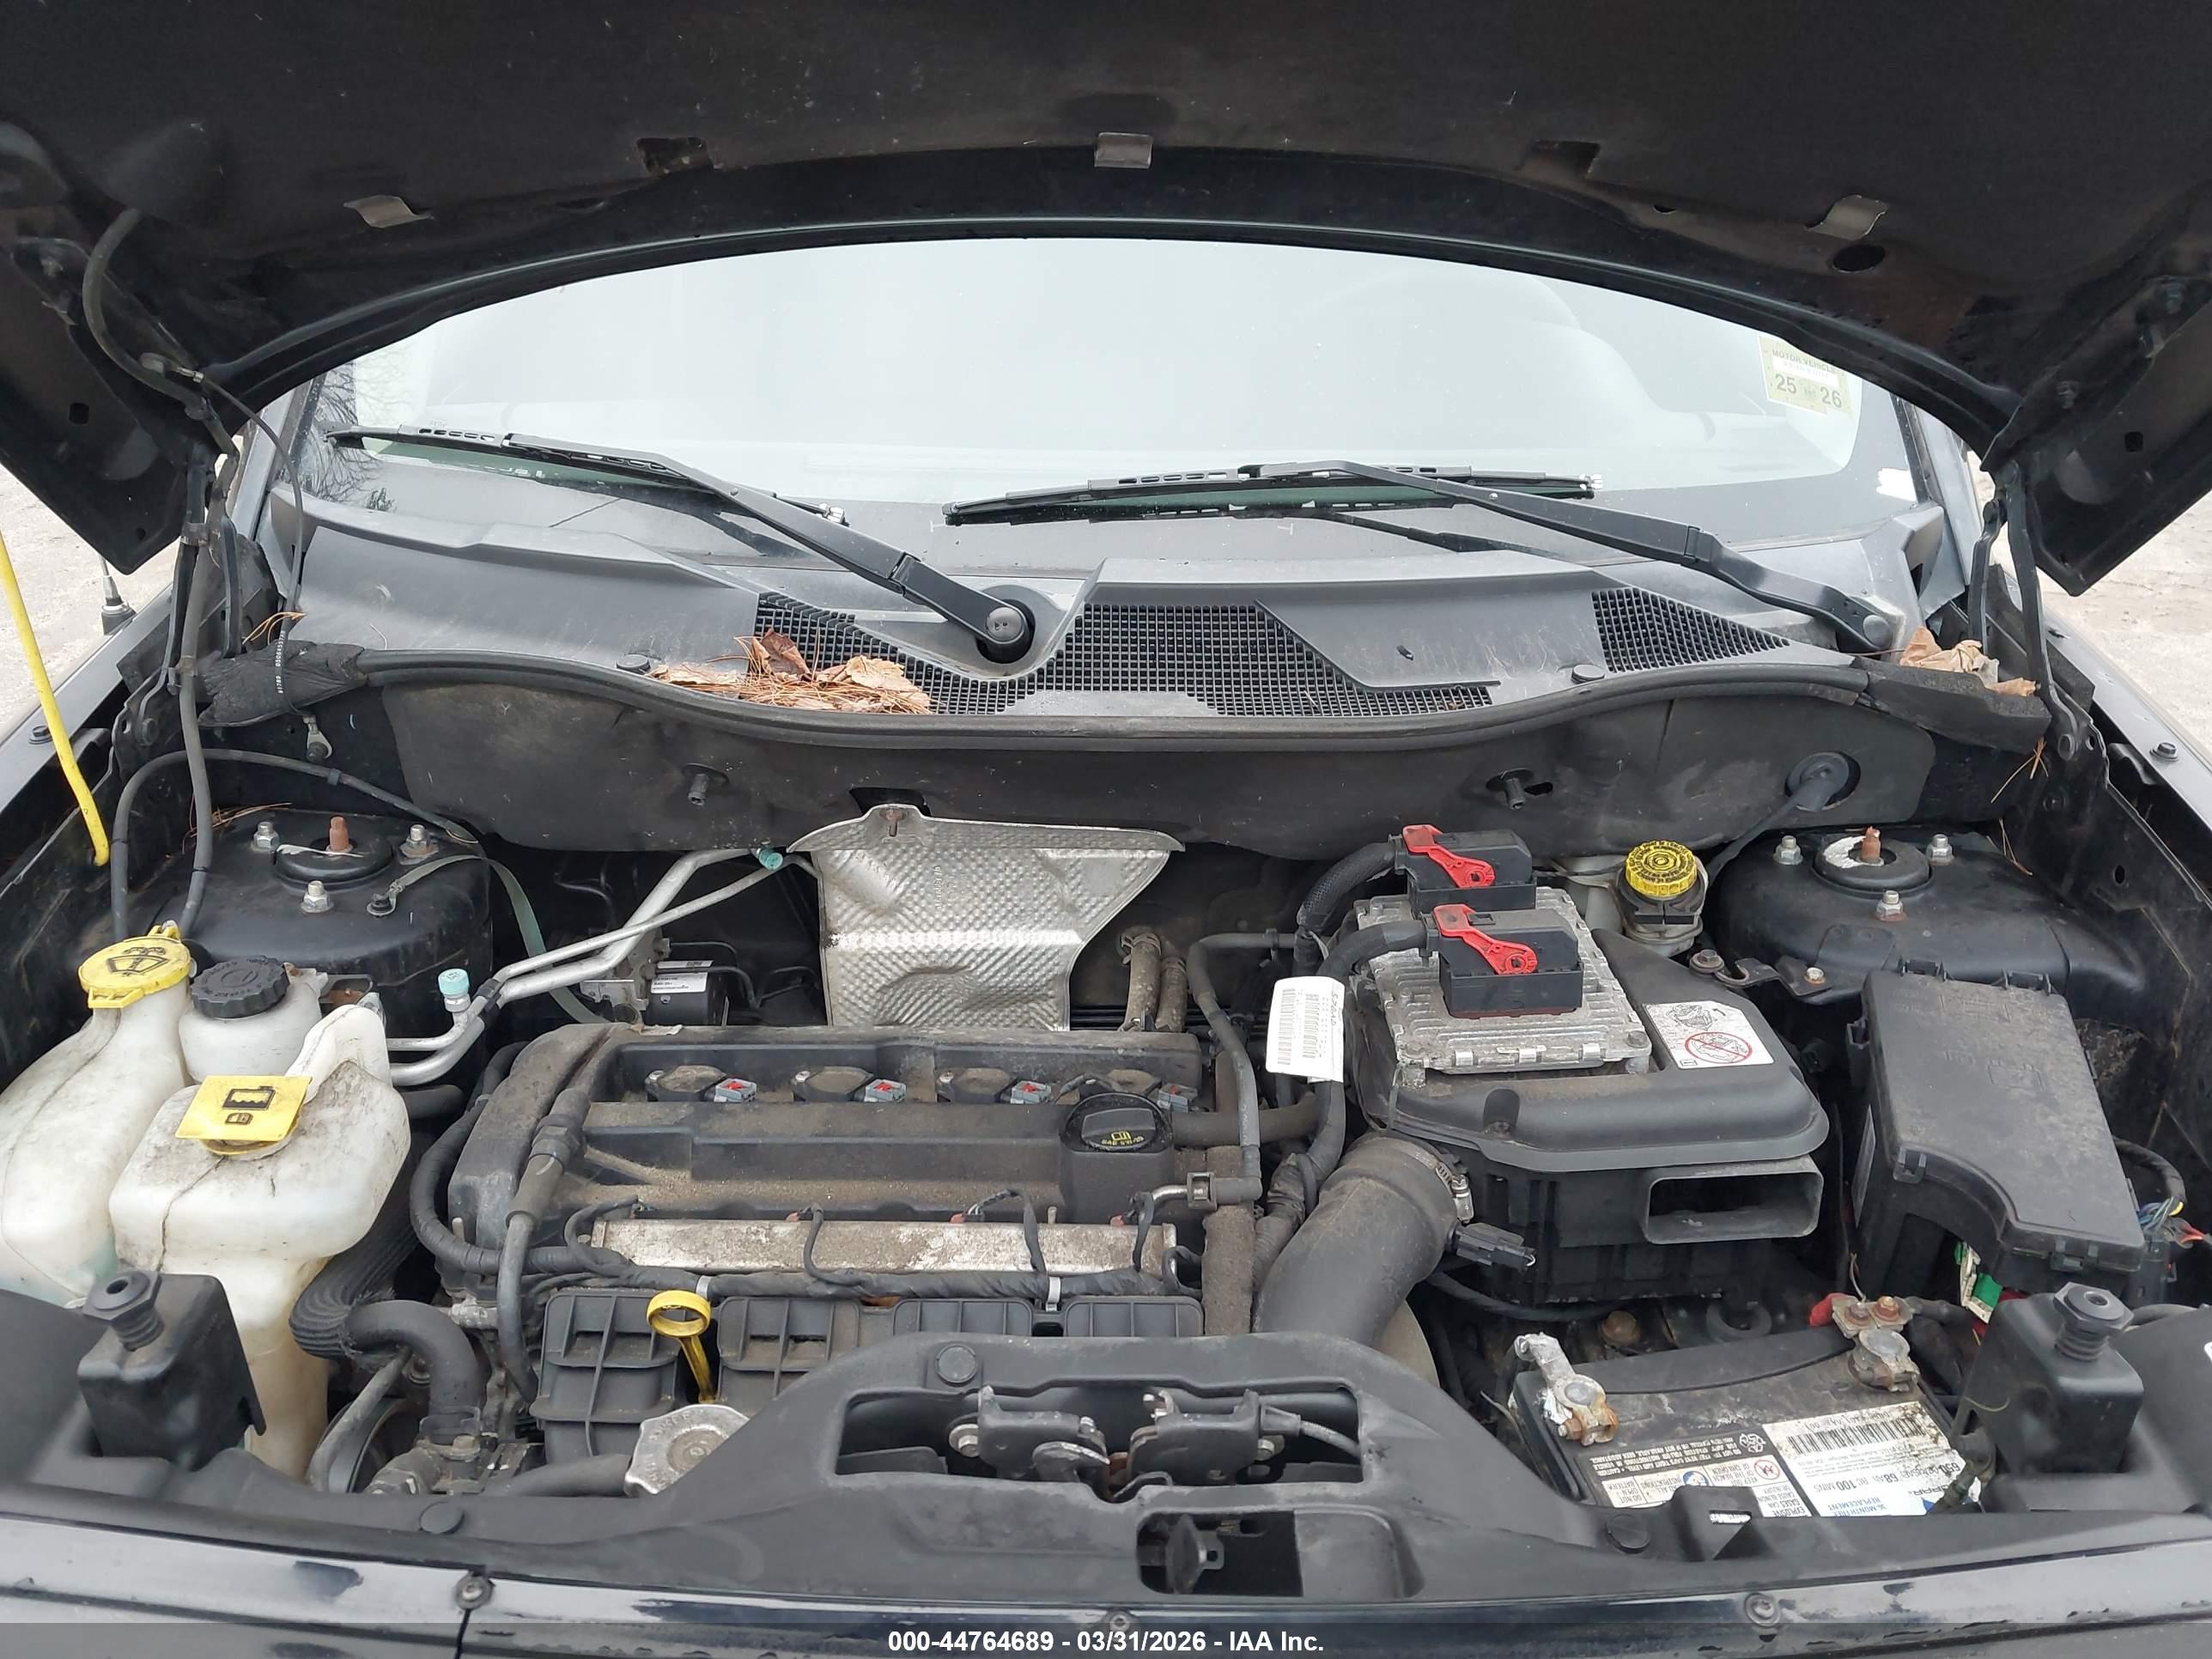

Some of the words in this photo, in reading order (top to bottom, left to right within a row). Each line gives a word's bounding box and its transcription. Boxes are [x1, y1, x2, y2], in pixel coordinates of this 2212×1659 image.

[1772, 349, 1802, 364] MOTOR
[1774, 374, 1797, 394] 25
[1820, 386, 1842, 408] 26
[1640, 1477, 1681, 1489] INSTRUCTIONS
[1856, 1477, 1869, 1486] RC
[1883, 1473, 1899, 1484] 68
[1814, 1483, 1836, 1493] MINS
[1836, 1480, 1857, 1492] 100
[1779, 1498, 1800, 1508] GASES
[1827, 1498, 1881, 1511] REPLACEMENT
[1771, 1506, 1806, 1516] EXPLOSIVE
